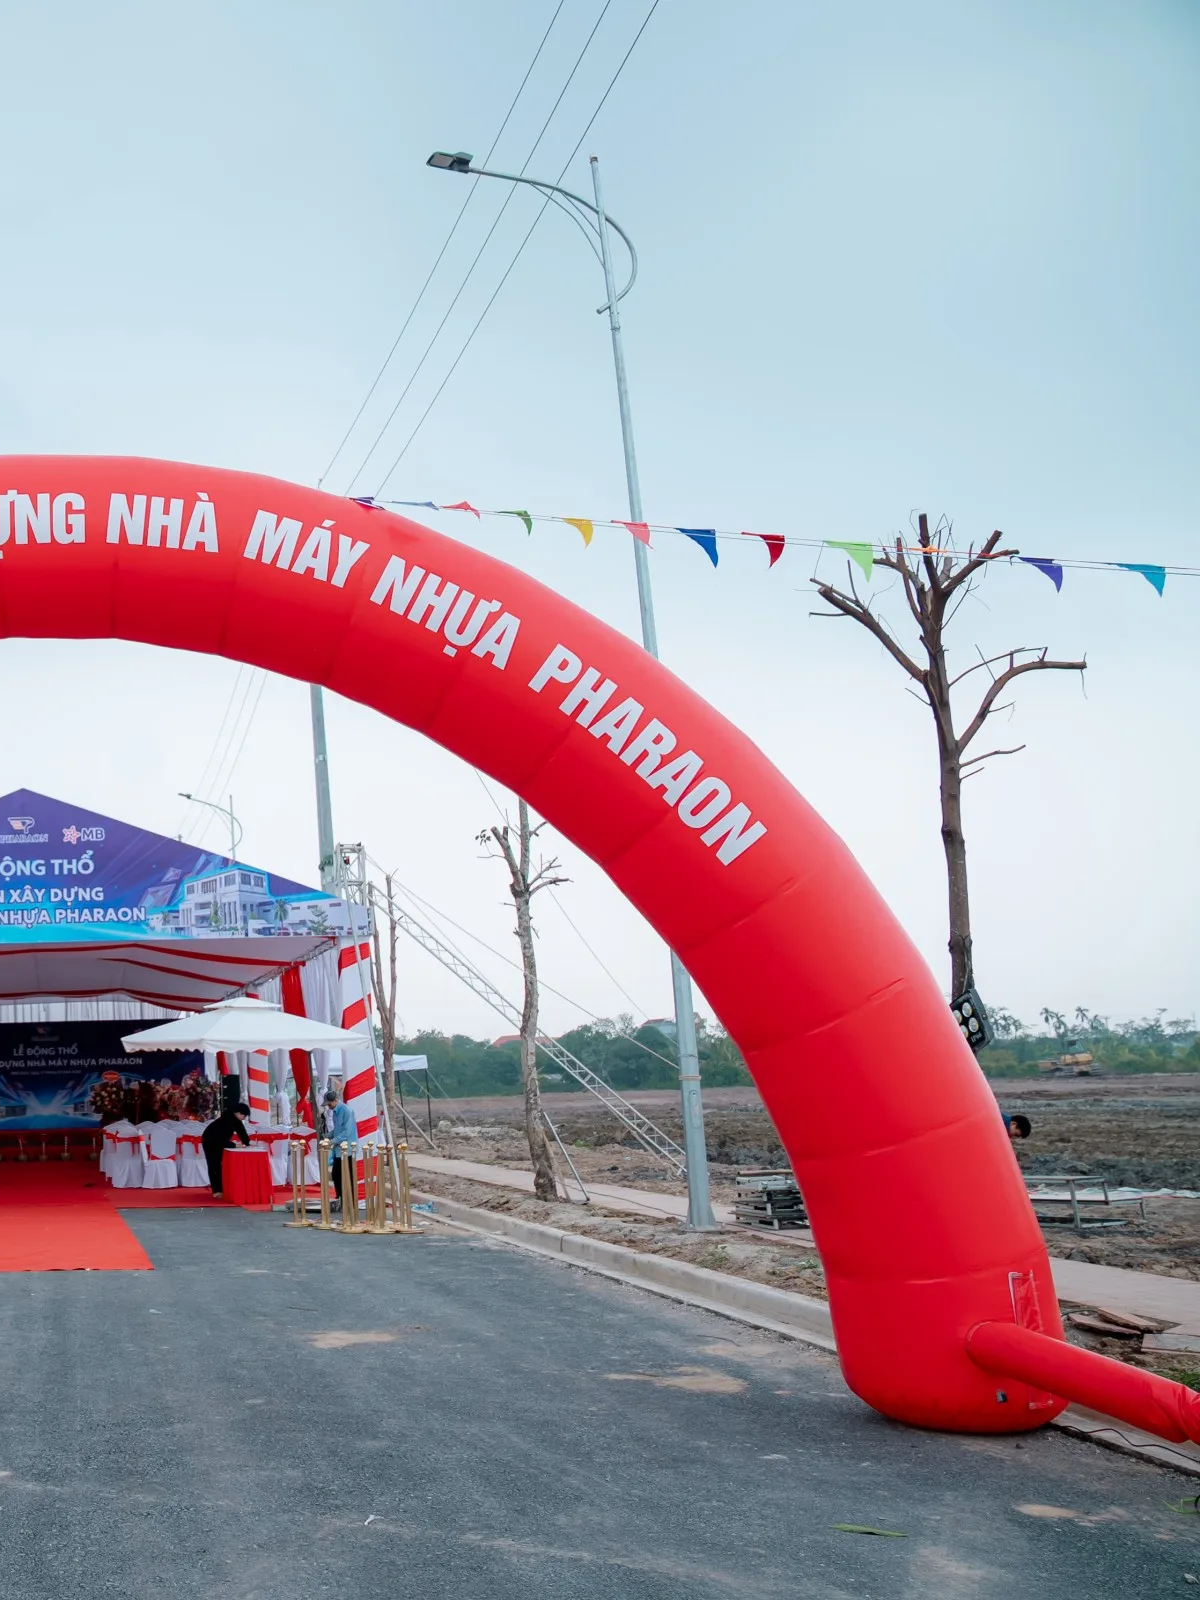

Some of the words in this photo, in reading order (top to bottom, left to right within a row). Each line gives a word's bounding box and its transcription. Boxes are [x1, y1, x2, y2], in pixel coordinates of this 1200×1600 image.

[105, 491, 220, 554] NHÀ
[242, 509, 371, 589] MÁY
[369, 554, 522, 671] NHỰA
[527, 642, 769, 867] PHARAON
[0, 833, 49, 845] PHARAON
[80, 827, 106, 842] MB
[50, 850, 95, 876] THỔ
[9, 885, 46, 904] XÂY
[50, 887, 105, 907] DỰNG
[55, 907, 147, 924] PHARAON
[69, 1058, 97, 1068] NHỰA
[98, 1057, 143, 1066] PHARAON
